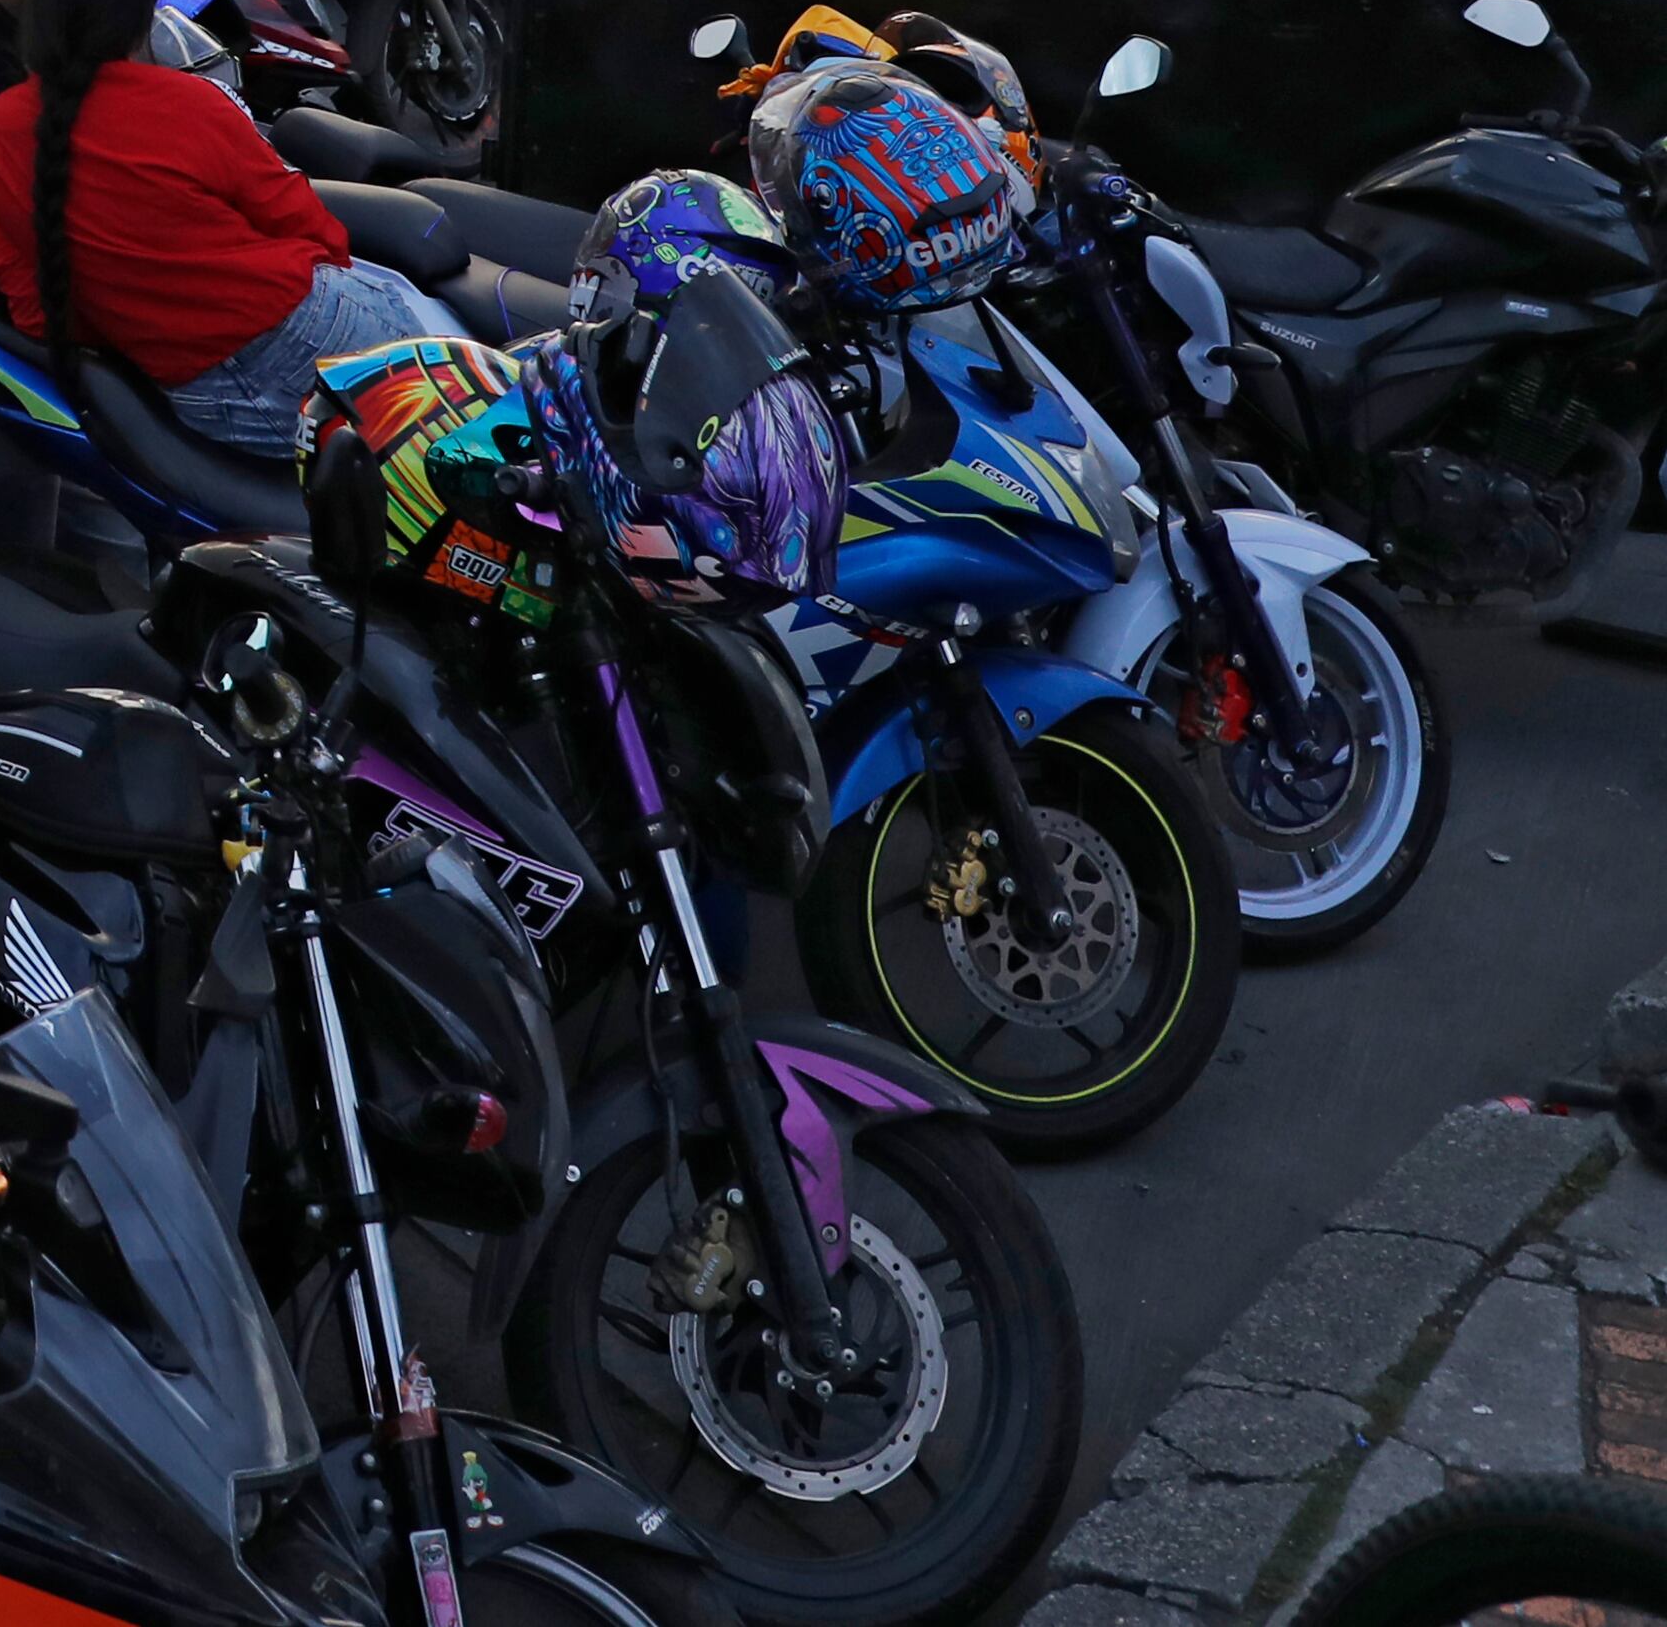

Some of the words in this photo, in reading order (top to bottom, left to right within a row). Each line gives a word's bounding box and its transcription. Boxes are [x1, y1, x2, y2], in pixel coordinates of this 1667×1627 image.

[1260, 321, 1317, 350] SUZUKI
[970, 460, 1039, 505] ECSTAR
[453, 550, 507, 584] agv
